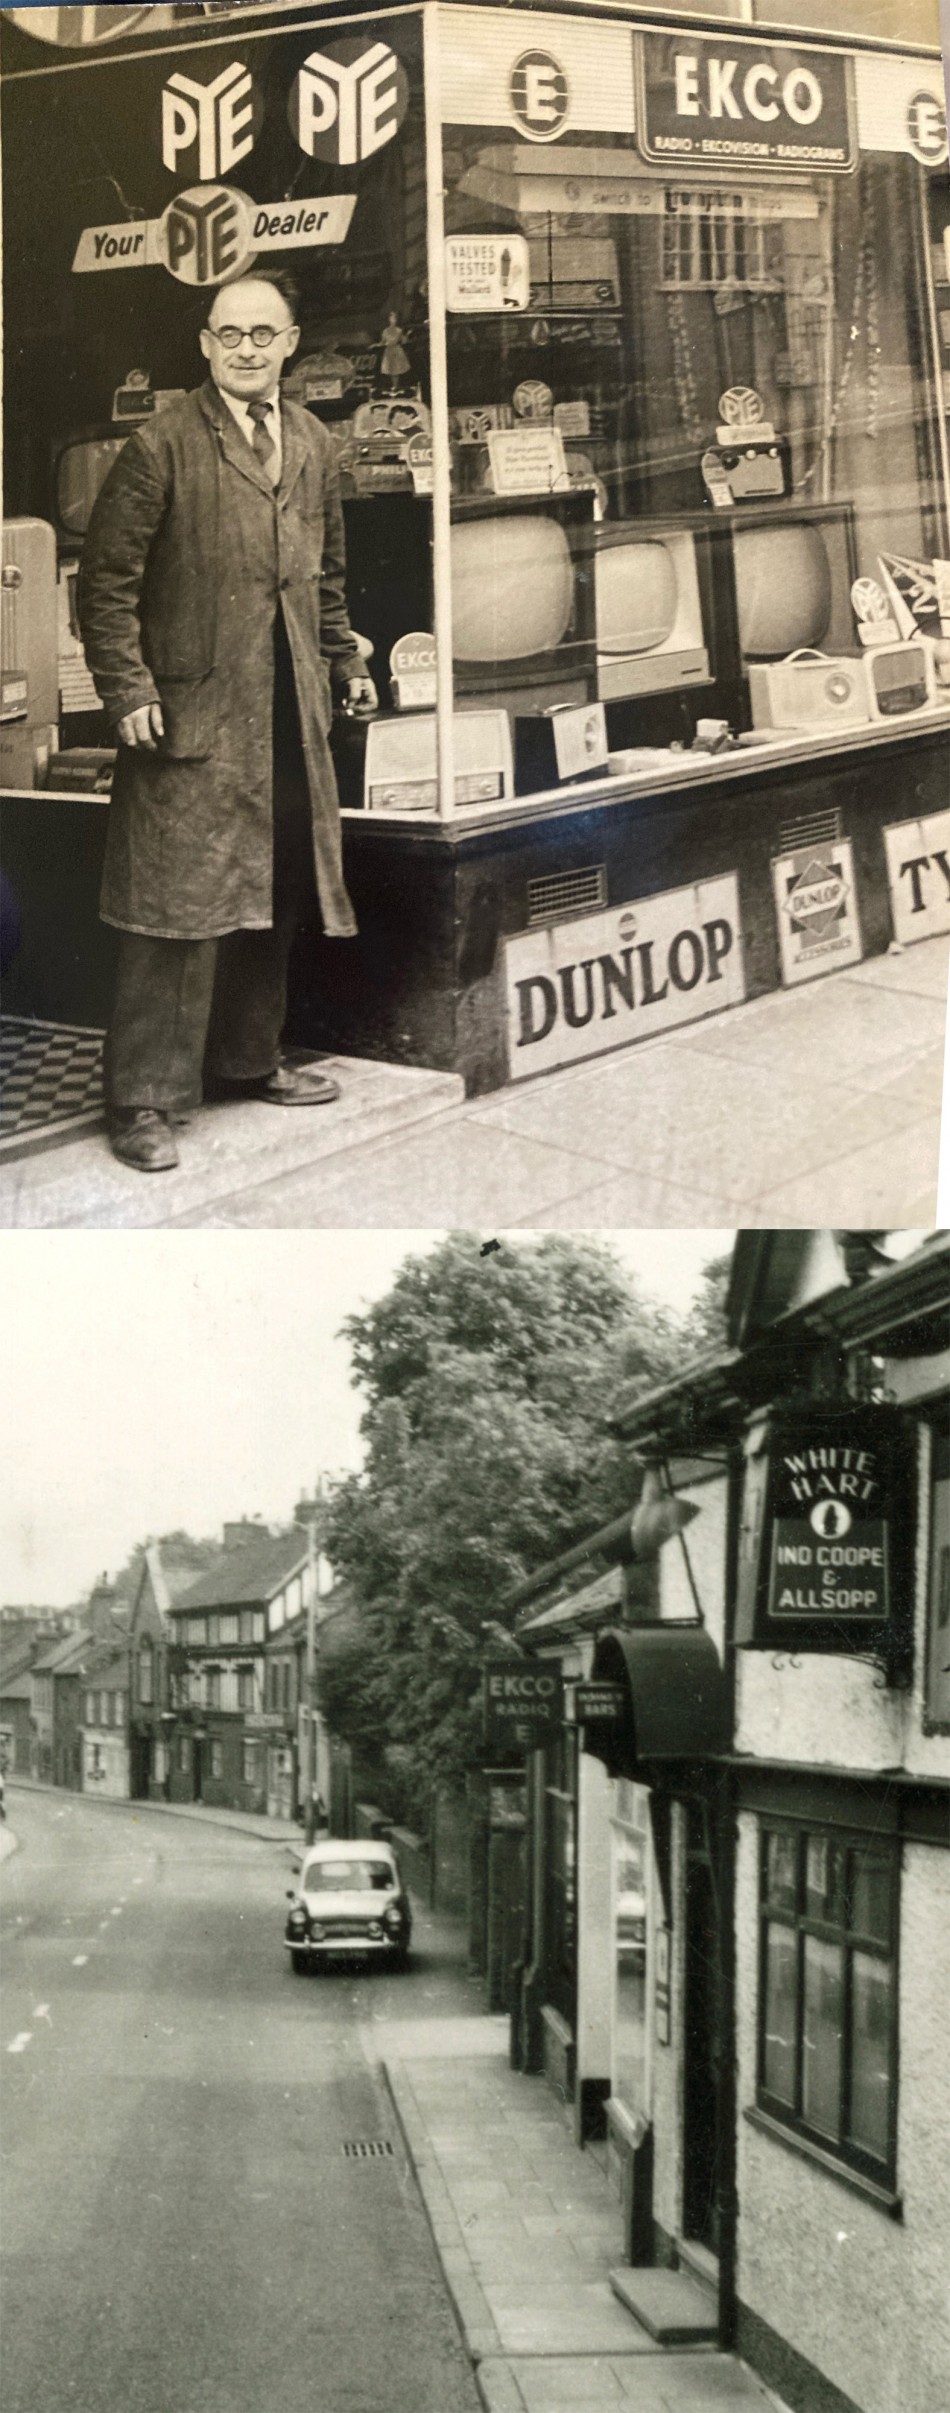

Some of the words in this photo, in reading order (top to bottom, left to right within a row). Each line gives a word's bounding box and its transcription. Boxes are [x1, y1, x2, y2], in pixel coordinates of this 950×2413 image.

[299, 41, 398, 165] PYE
[675, 55, 822, 125] EKCO
[162, 61, 253, 180] PYE
[655, 136, 692, 150] RADIO
[702, 139, 769, 156] EKCOVISION
[777, 144, 845, 160] RADIOGRAMS
[93, 232, 144, 260] Your
[167, 192, 238, 282] PYE
[253, 208, 329, 239] Dealer
[451, 245, 495, 259] VALVES
[452, 261, 496, 276] TESTED
[793, 884, 841, 912] DUNLOP
[514, 918, 734, 1047] DUNLOP
[784, 1447, 877, 1475] WHITE
[790, 1473, 879, 1501] HART
[777, 1545, 813, 1566] IND
[816, 1546, 884, 1567] COOPE
[822, 1568, 838, 1587] &
[778, 1587, 878, 1609] ALLSOPP
[489, 1675, 556, 1697] EKCO
[495, 1702, 551, 1717] RADIO
